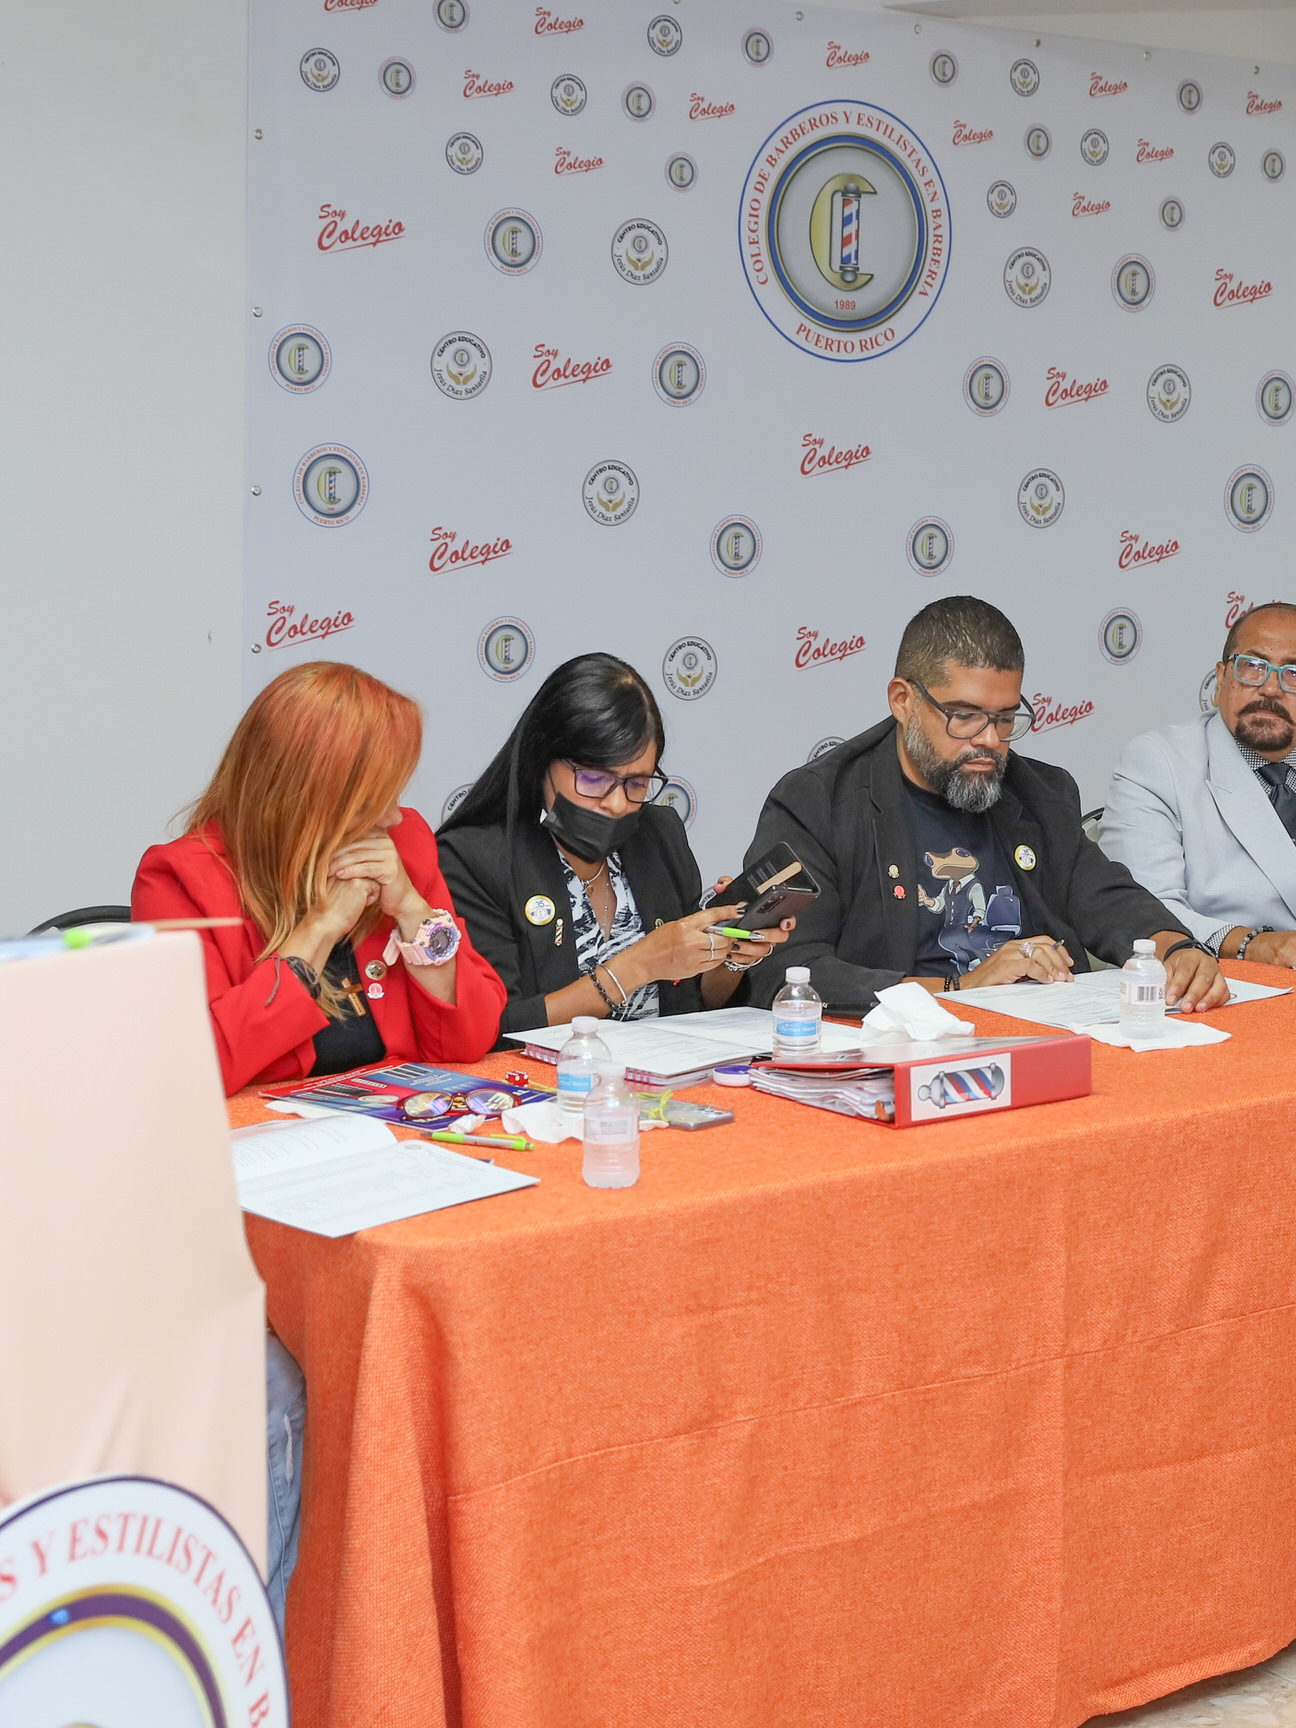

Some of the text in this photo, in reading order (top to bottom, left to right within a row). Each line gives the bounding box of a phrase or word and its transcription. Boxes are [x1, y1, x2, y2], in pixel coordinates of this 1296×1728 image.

[534, 16, 584, 35] Colegio
[826, 50, 870, 67] Colegio
[464, 80, 514, 98] Colegio
[1089, 80, 1128, 96] Colegio
[689, 102, 735, 120] Colegio
[1246, 99, 1282, 115] Colegio
[842, 111, 852, 124] Y
[766, 111, 839, 171] BARBEROS
[856, 113, 928, 177] ESTILISTAS
[952, 129, 993, 146] Colegio
[1136, 147, 1174, 163] Colegio
[554, 156, 603, 174] Colegio
[754, 172, 772, 195] DE
[924, 179, 939, 203] EN
[318, 204, 346, 221] Soy
[1072, 200, 1110, 216] Colegio
[317, 219, 405, 251] Colegio
[747, 198, 768, 286] COLEGIO
[1214, 268, 1234, 282] Soy
[1213, 281, 1272, 307] Colegio
[834, 299, 856, 310] 1989
[795, 322, 896, 354] PUERTO RICO
[533, 344, 559, 360] Soy
[532, 357, 613, 389] Colegio
[1046, 367, 1067, 381] Soy
[1045, 378, 1109, 407] Colegio
[802, 433, 824, 448] Soy
[800, 444, 872, 475] Colegio
[430, 526, 457, 543] Soy
[1119, 530, 1140, 543] Soy
[429, 537, 512, 572] Colegio
[1119, 539, 1180, 569] Colegio
[1226, 591, 1246, 604] Soy
[267, 600, 294, 617] Soy
[266, 610, 354, 648] Colegio
[795, 626, 819, 641] Soy
[795, 635, 866, 669] Colegio
[1031, 693, 1052, 707] Soy
[1031, 700, 1094, 732] Colegio
[700, 891, 715, 907] ENTRO
[29, 1528, 57, 1579] Y
[66, 1511, 243, 1626] ESTILISTAS
[231, 1616, 265, 1689] EN
